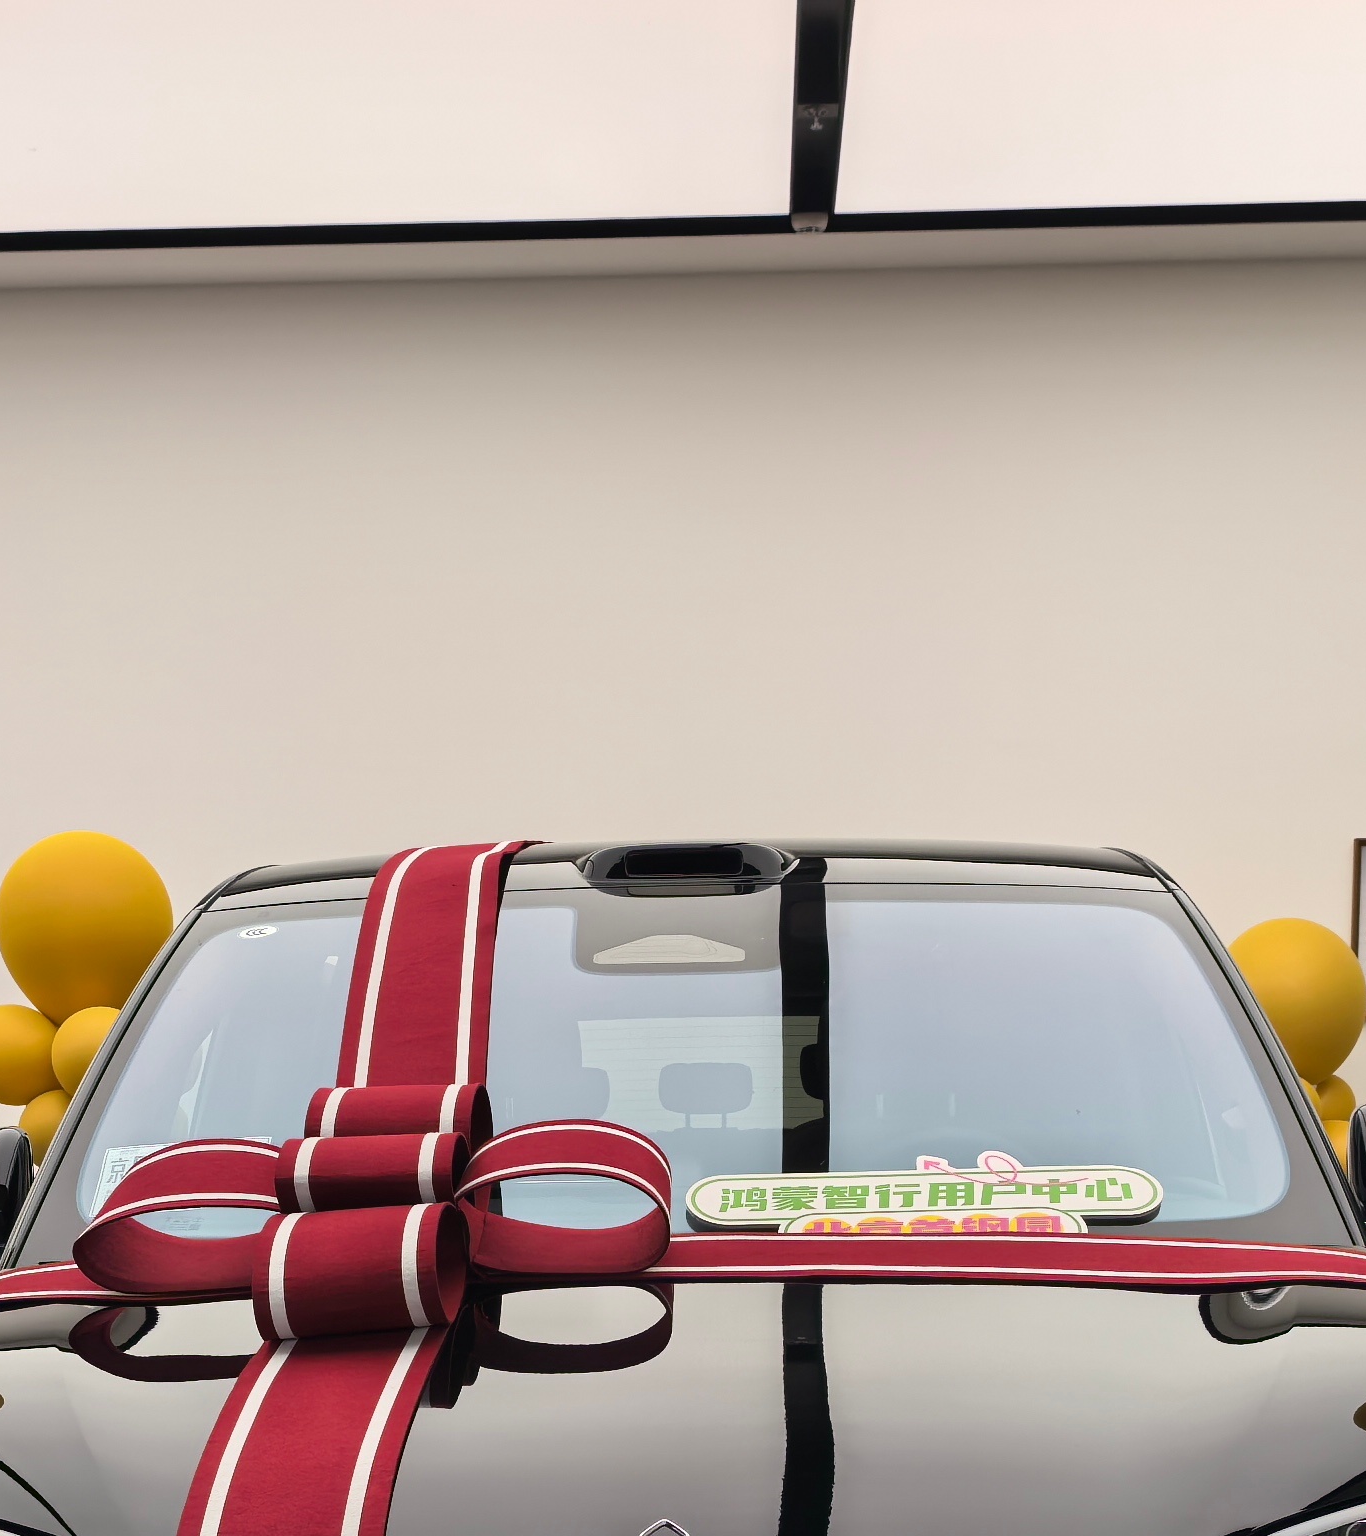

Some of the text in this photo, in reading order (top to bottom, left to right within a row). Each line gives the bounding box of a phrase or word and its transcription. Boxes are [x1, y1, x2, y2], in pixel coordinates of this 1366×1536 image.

[720, 1177, 1133, 1214] 鸿蒙智行用户中心
